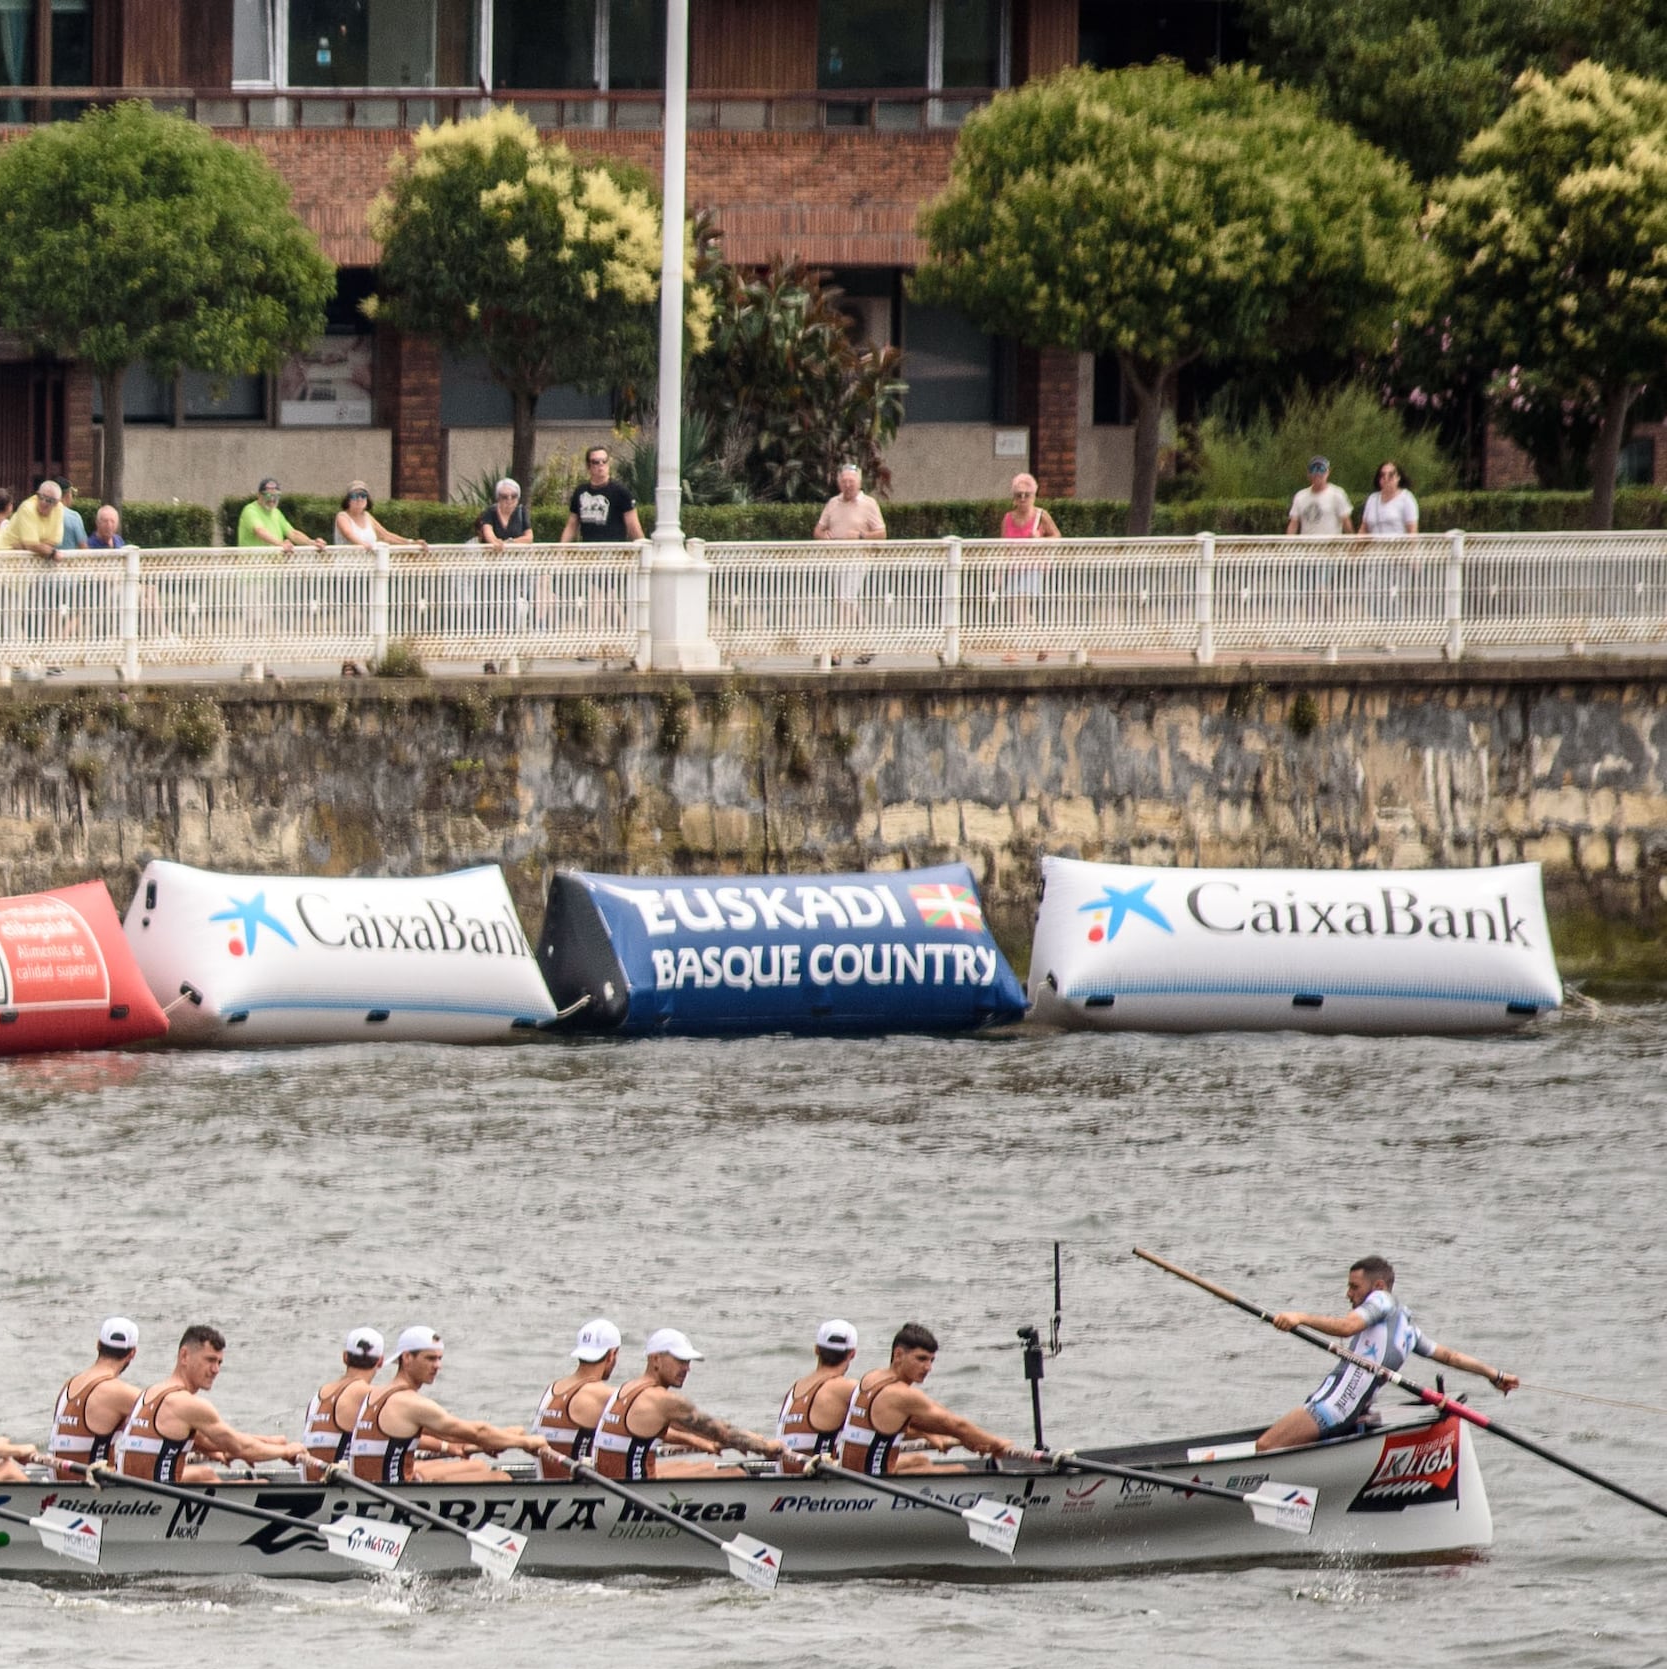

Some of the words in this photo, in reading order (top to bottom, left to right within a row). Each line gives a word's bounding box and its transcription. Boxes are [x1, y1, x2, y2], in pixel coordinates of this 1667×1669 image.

[636, 885, 907, 936] EUSKADI
[1186, 882, 1533, 948] CaixaBank
[295, 892, 535, 959] CaixaBank
[16, 964, 55, 979] calidad
[57, 962, 98, 982] superior
[653, 943, 801, 990] BASQUE
[810, 941, 996, 988] COUNTRY
[1405, 1444, 1453, 1476] LIGA
[57, 1498, 163, 1516] Bizkaialde
[796, 1495, 878, 1513] Petronor
[1006, 1494, 1051, 1506] Temo
[1276, 1505, 1312, 1521] NORTON
[608, 1522, 681, 1539] bilbao
[63, 1532, 99, 1550] NORTON
[365, 1535, 401, 1557] MATRA
